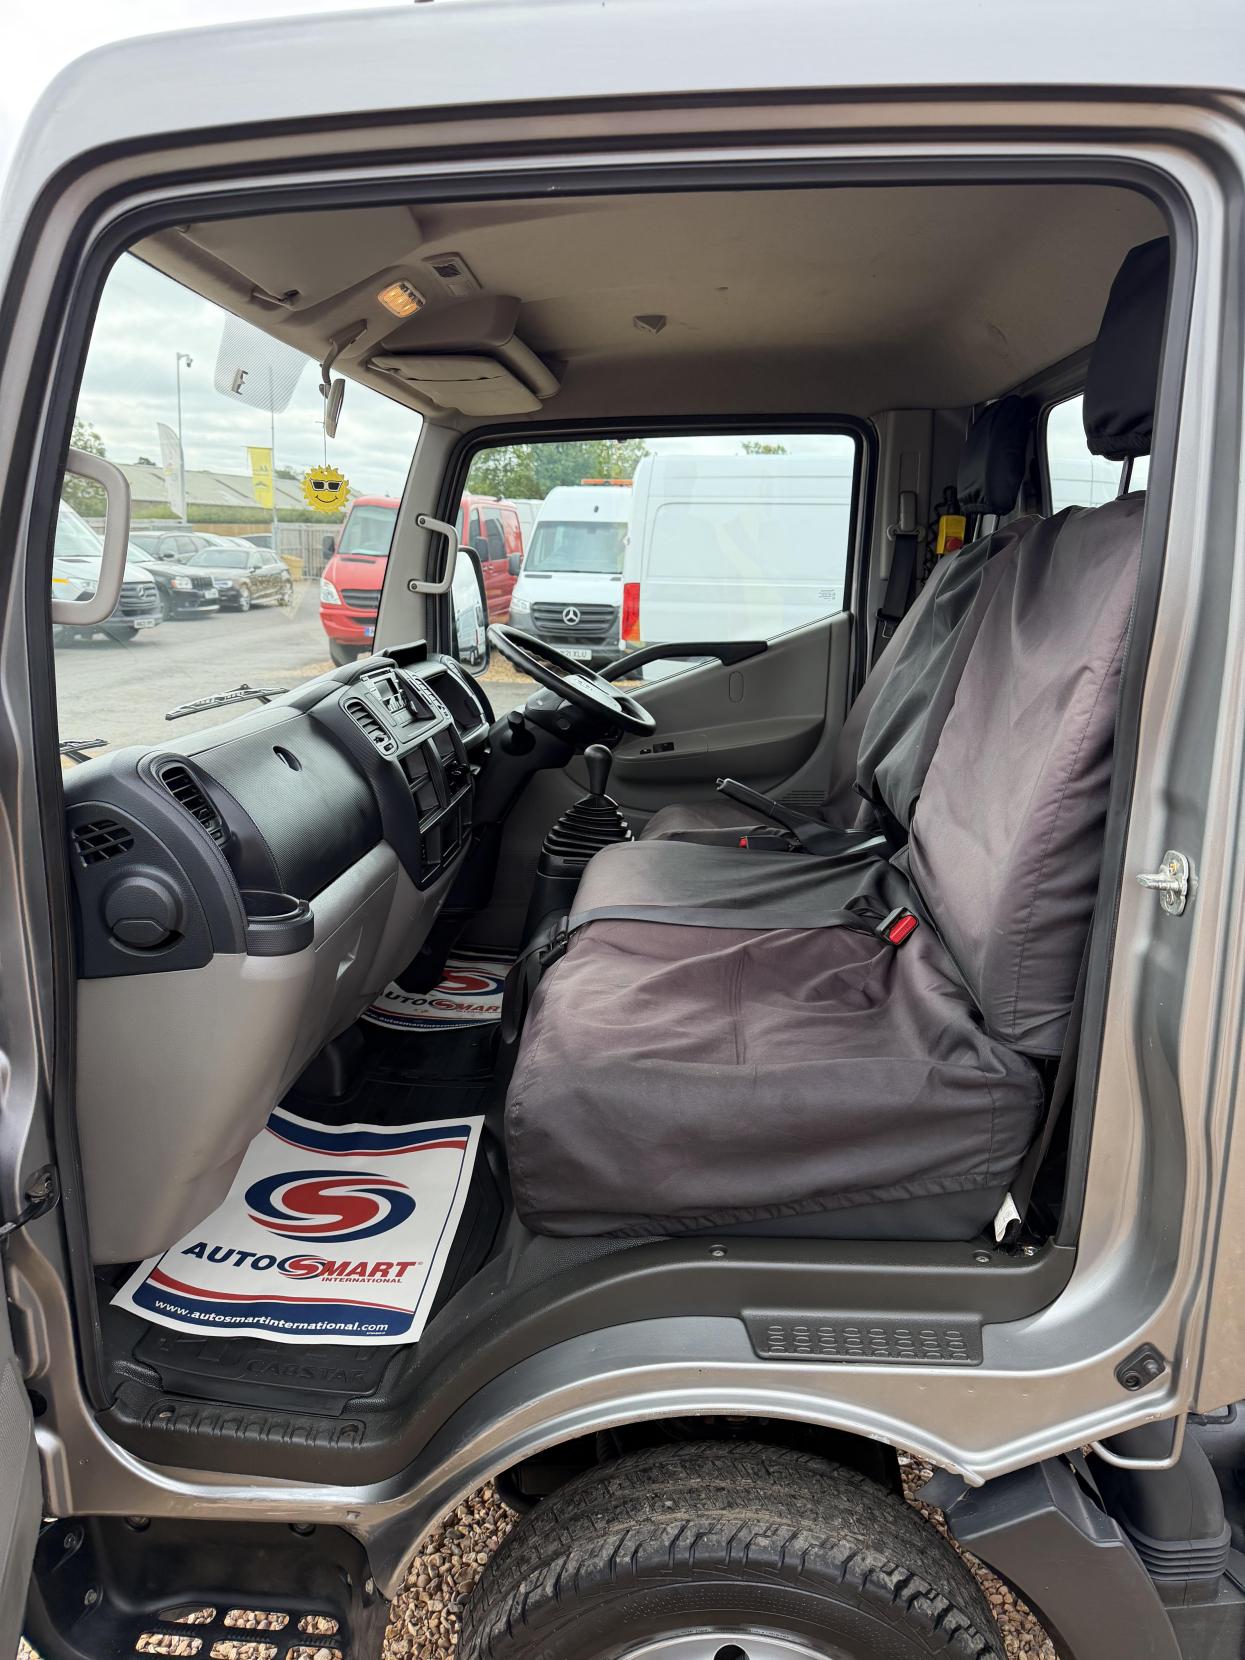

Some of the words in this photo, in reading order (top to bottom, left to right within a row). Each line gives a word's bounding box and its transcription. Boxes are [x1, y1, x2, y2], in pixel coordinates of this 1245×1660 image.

[379, 990, 501, 1012] UTOSMAR
[181, 1241, 417, 1280] AUTOSMART
[321, 1276, 403, 1284] INTERNATIONAL
[154, 1300, 389, 1332] www.autosmartinternational.com
